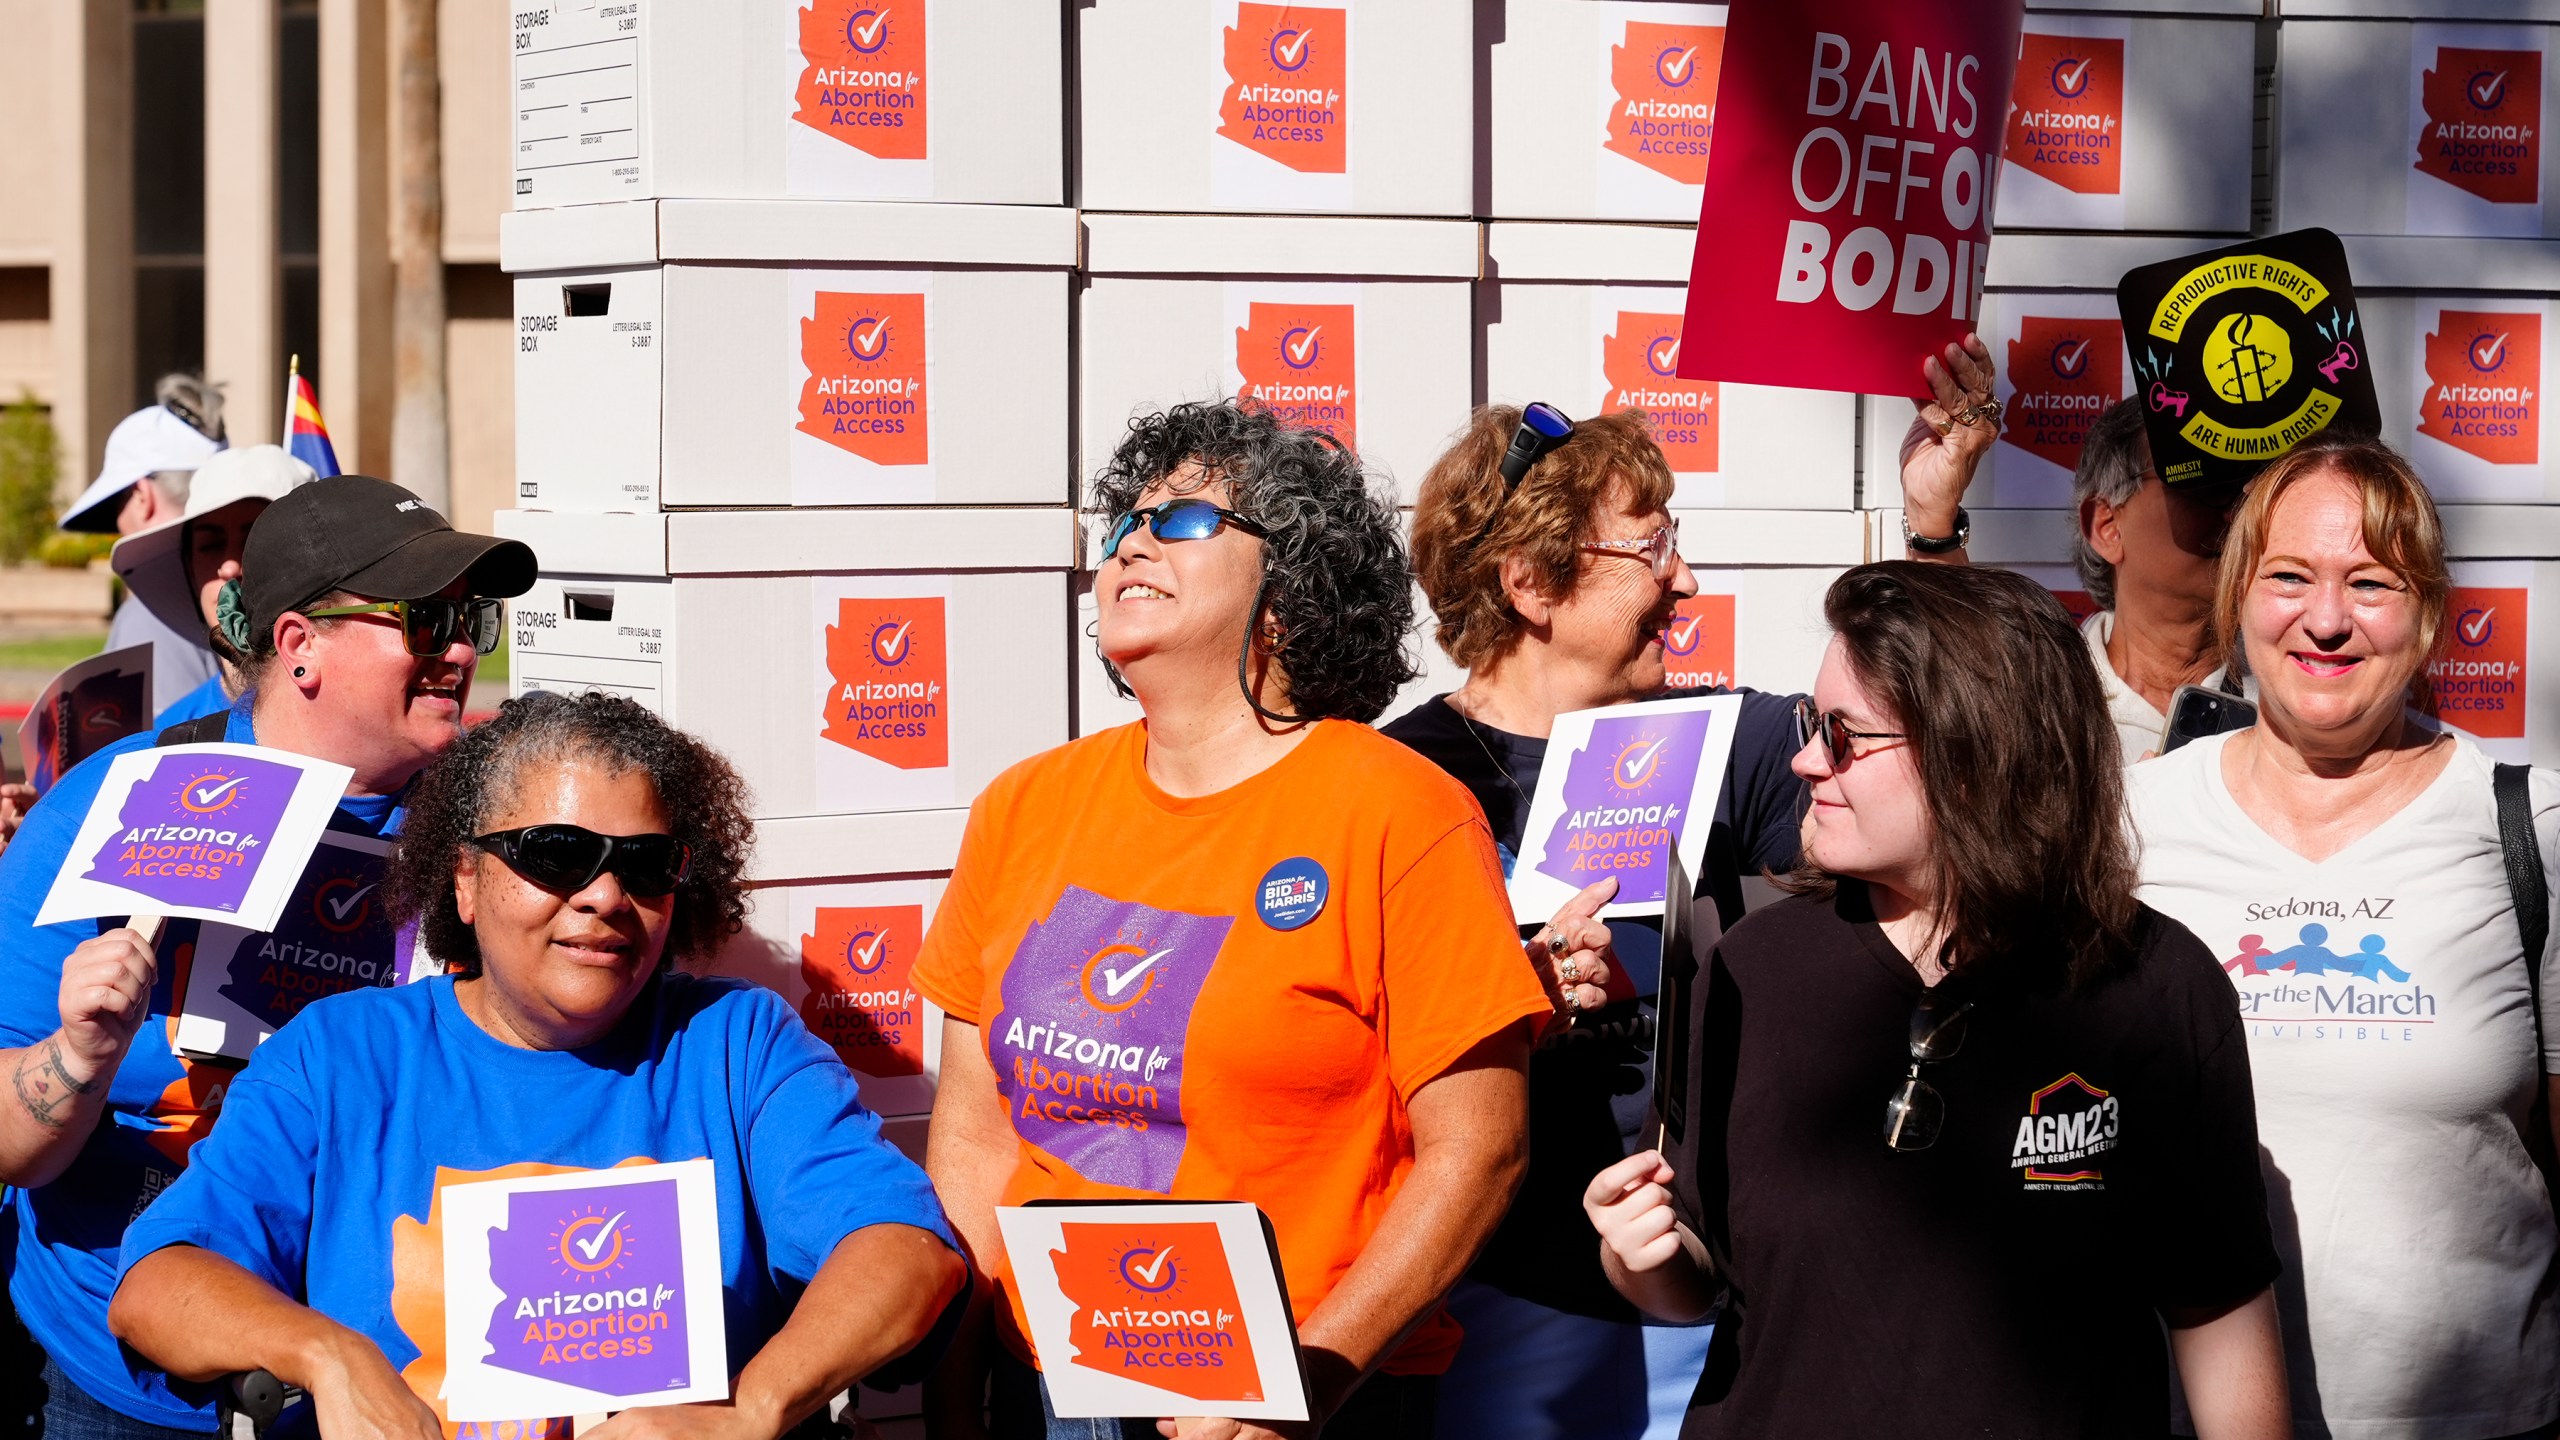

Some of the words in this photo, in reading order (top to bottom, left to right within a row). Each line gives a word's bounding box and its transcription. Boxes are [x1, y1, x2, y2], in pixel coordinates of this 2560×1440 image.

[629, 4, 637, 14] SIZE
[516, 9, 549, 30] STORAGE
[619, 18, 637, 31] S-3887
[516, 32, 531, 49] BOX
[814, 66, 902, 87] Arizona
[905, 71, 919, 92] for
[1806, 31, 1980, 139] BANS
[819, 87, 914, 109] Abortion
[1238, 83, 1323, 105] Arizona
[1325, 89, 1340, 109] for
[830, 108, 904, 127] Access
[1243, 104, 1334, 125] Abortion
[1625, 98, 1707, 119] Arizona
[2021, 109, 2100, 129] Arizona
[2102, 114, 2116, 133] for
[1253, 124, 1324, 143] Access
[2024, 129, 2110, 148] Abortion
[2436, 121, 2517, 140] Arizona
[2520, 125, 2533, 144] for
[1639, 138, 1708, 155] Access
[2440, 141, 2528, 158] Abortion
[2034, 148, 2100, 165] Access
[1792, 126, 1935, 222] OFF
[2449, 160, 2517, 175] Access
[517, 179, 532, 194] ULINE
[2159, 263, 2258, 332] REPRODUCTIVE
[2262, 265, 2316, 302] RIGHTS
[521, 316, 557, 332] STORAGE
[643, 322, 652, 331] SIZE
[521, 336, 538, 352] BOX
[632, 336, 651, 347] S-3887
[817, 374, 902, 395] Arizona
[905, 377, 919, 398] for
[1252, 382, 1333, 401] Arizona
[1336, 384, 1349, 405] for
[2438, 384, 2517, 402] Arizona
[2520, 386, 2534, 406] for
[822, 396, 915, 415] Abortion
[1617, 388, 1697, 407] Arizona
[1700, 391, 1713, 412] for
[2021, 392, 2100, 409] Arizona
[2103, 394, 2115, 412] for
[1648, 408, 1708, 426] ortion
[2442, 403, 2528, 420] Abortion
[833, 417, 905, 434] Access
[2191, 424, 2222, 449] ARE
[2224, 434, 2280, 455] HUMAN
[2280, 399, 2329, 445] RIGHTS
[2451, 421, 2518, 437] Access
[2034, 430, 2085, 445] Acce
[2165, 460, 2201, 476] AMNESTY
[2166, 471, 2204, 484] INTERNATIONAL
[521, 482, 537, 497] ULINE
[517, 611, 557, 628] STORAGE
[517, 630, 535, 647] BOX
[651, 628, 662, 638] SIZE
[639, 642, 661, 654] S-3887
[2427, 658, 2504, 677] Arizona
[2507, 661, 2520, 680] for
[522, 681, 540, 689] CONTENTS
[1665, 671, 1712, 687] zona
[2432, 677, 2515, 695] Abortion
[841, 680, 924, 701] Arizona
[927, 680, 941, 702] for
[846, 700, 936, 722] Abortion
[2439, 697, 2505, 711] Access
[857, 722, 926, 740] Access
[1566, 805, 1661, 831] Arizona
[1661, 803, 1681, 828] for
[121, 823, 237, 845] Arizona
[236, 833, 261, 852] for
[1565, 825, 1670, 853] Abortion
[118, 842, 245, 867] Abortion
[1570, 850, 1652, 872] Access
[123, 861, 223, 880] Access
[1265, 880, 1316, 900] BIDEN
[1266, 877, 1296, 888] ARIZONA
[1265, 892, 1316, 910] HARRIS
[2245, 896, 2346, 923] Sedona,
[2352, 897, 2395, 919] AZ
[258, 938, 377, 980] Arizona
[379, 963, 401, 988] for
[816, 989, 900, 1009] Arizona
[902, 988, 917, 1009] for
[2272, 984, 2311, 1003] the
[2315, 985, 2436, 1016] March
[821, 1008, 912, 1030] Abortion
[833, 1030, 902, 1048] Access
[2254, 1025, 2412, 1041] IVISIBLE
[1004, 1016, 1144, 1072] Arizona
[1144, 1045, 1172, 1082] for
[1013, 1055, 1158, 1110] Abortion
[1020, 1093, 1149, 1132] Access
[2012, 1096, 2119, 1157] AGM23
[2011, 1154, 2046, 1169] ANNUAL
[2047, 1150, 2086, 1164] GENERAL
[2023, 1183, 2052, 1191] AMNESTY
[514, 1286, 648, 1320] Arizona
[652, 1283, 675, 1311] for
[522, 1309, 668, 1344] Abortion
[1091, 1306, 1211, 1328] Arizona
[1216, 1308, 1234, 1331] for
[1104, 1328, 1234, 1349] Abortion
[539, 1335, 653, 1366] Access
[1124, 1350, 1224, 1368] Access
